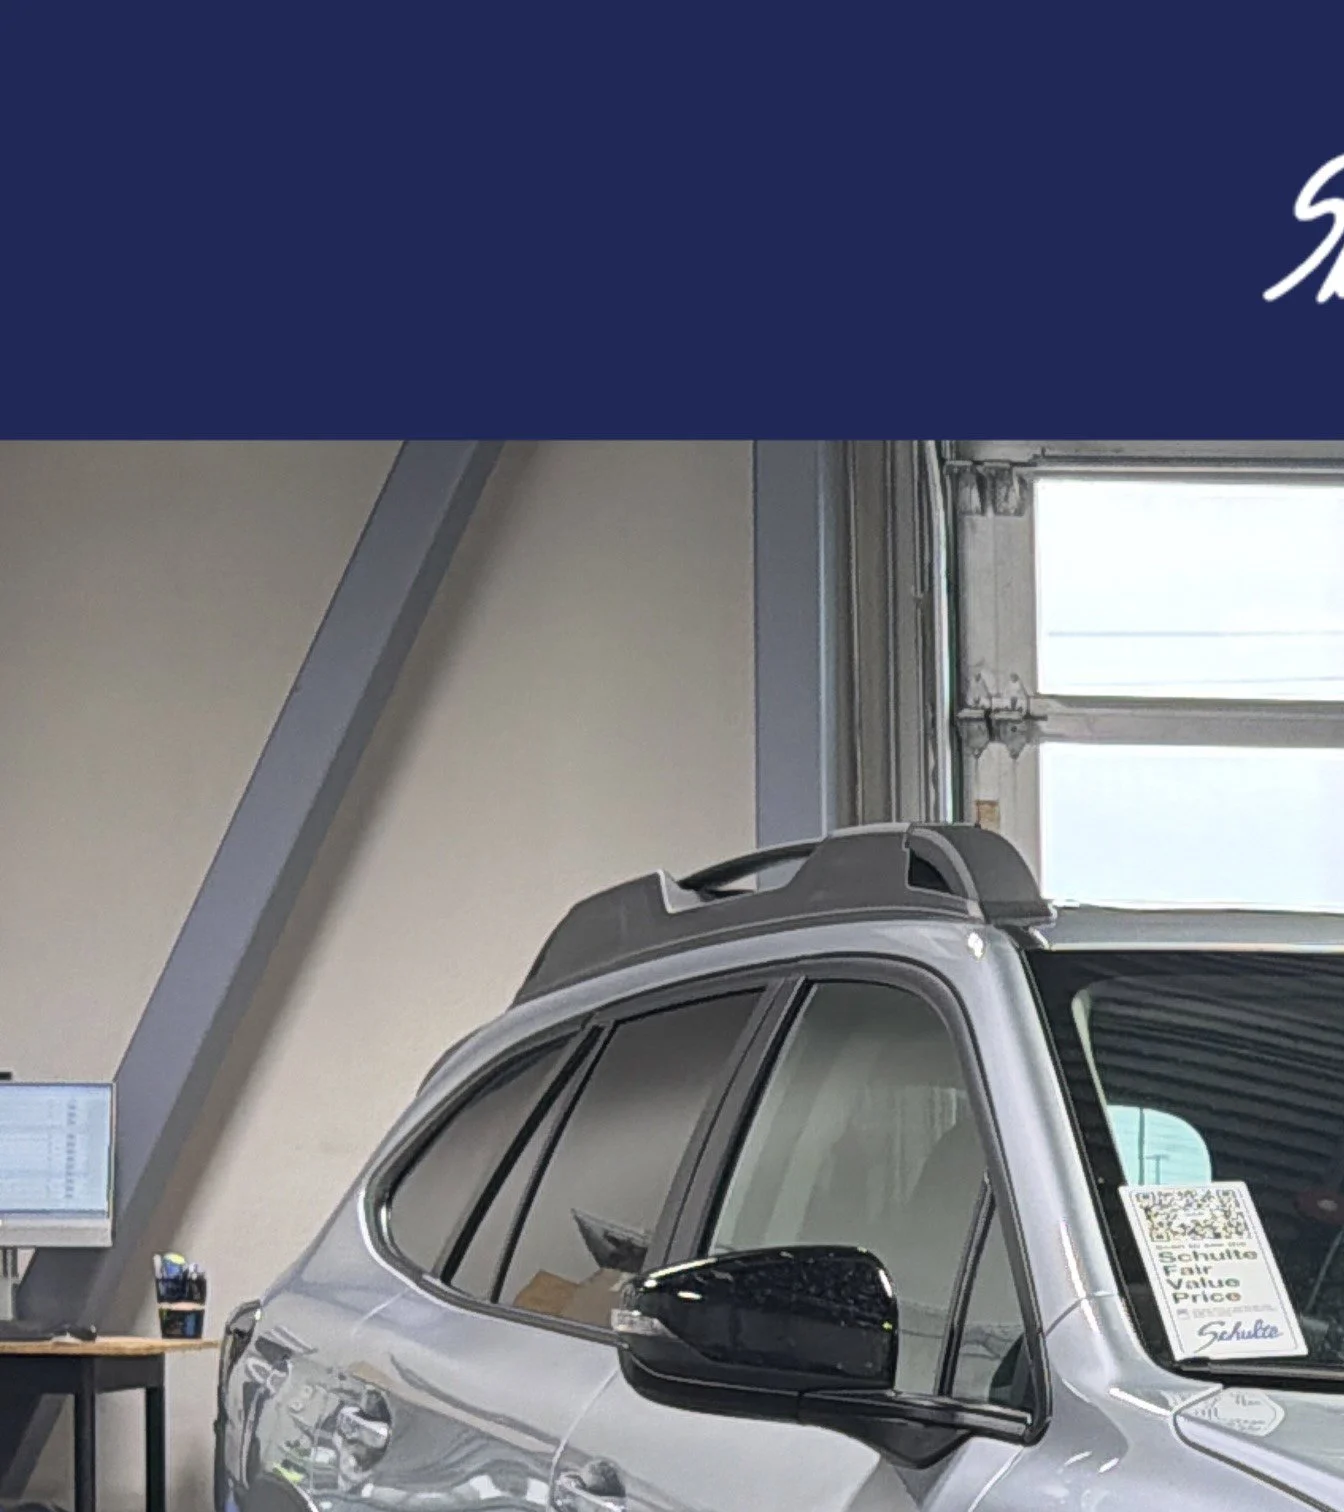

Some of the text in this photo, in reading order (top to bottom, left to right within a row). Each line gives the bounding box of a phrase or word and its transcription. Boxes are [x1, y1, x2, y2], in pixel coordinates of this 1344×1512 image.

[1158, 1248, 1258, 1263] Schulte
[1163, 1264, 1213, 1277] Fair
[1166, 1277, 1240, 1290] Value
[1172, 1290, 1241, 1304] Price
[1194, 1318, 1284, 1354] Schulte
